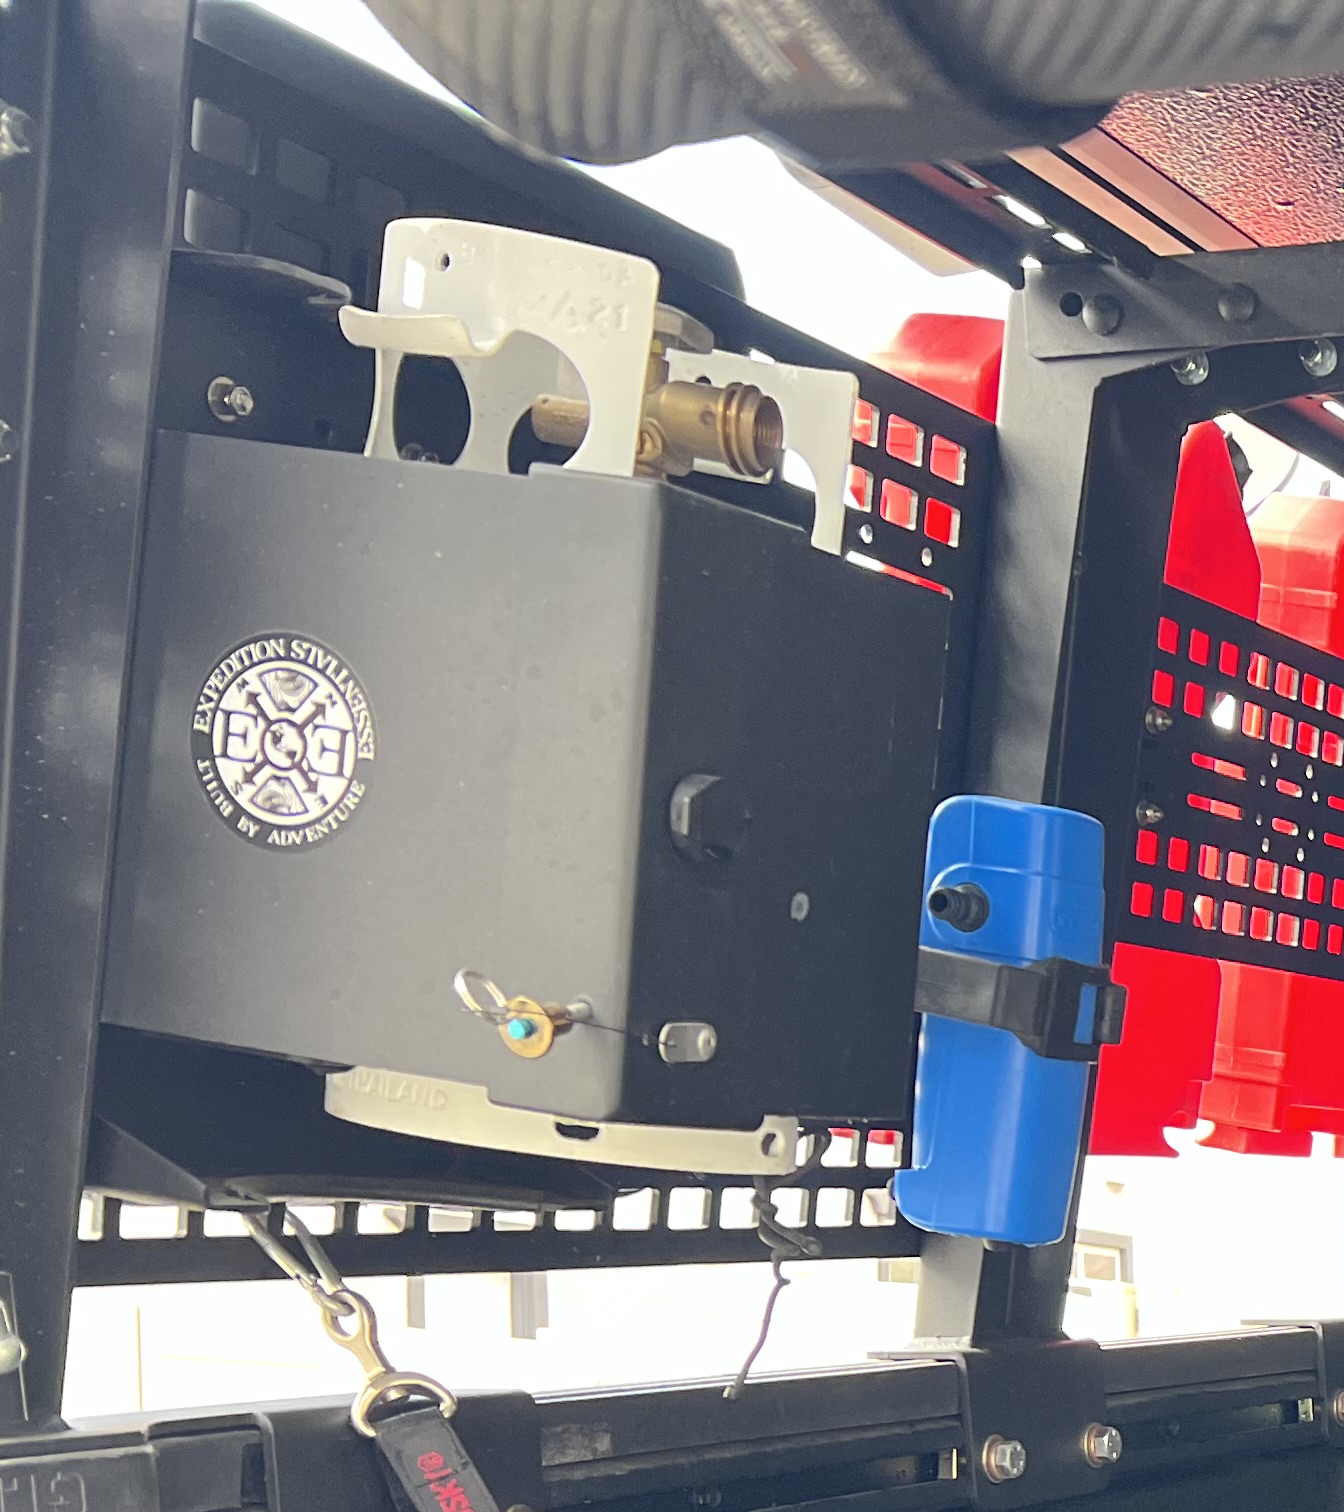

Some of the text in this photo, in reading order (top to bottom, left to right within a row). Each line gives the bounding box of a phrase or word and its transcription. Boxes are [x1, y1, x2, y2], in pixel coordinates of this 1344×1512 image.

[193, 638, 376, 761] EXPEDITION ESSENTIALS
[196, 759, 367, 846] BUILT BY ADVENTURE
